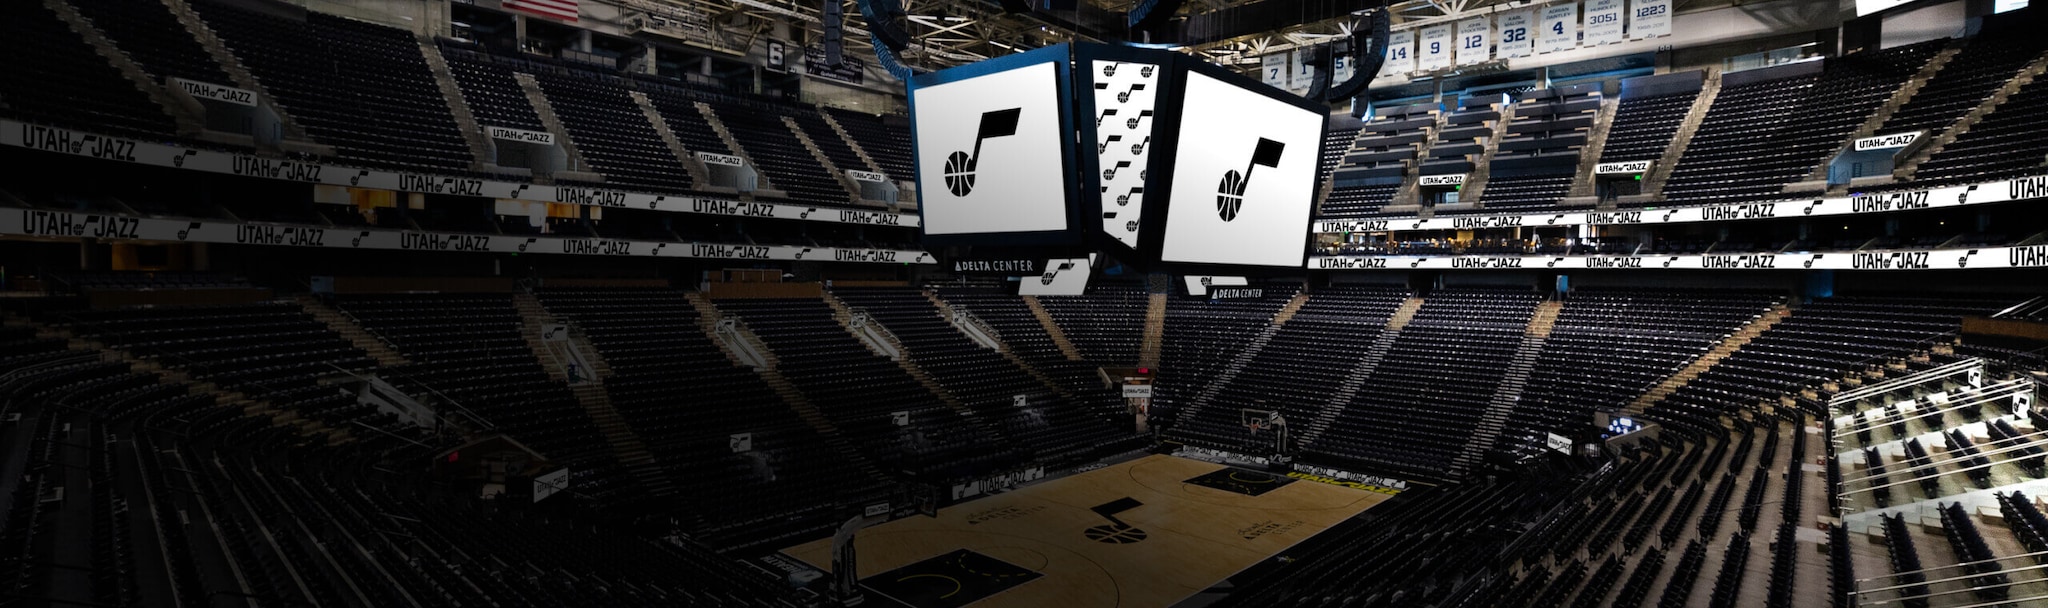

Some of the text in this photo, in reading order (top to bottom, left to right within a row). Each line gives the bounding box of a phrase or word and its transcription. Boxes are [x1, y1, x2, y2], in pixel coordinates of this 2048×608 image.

[1636, 4, 1666, 17] 1223
[1590, 13, 1617, 25] 3051
[1504, 27, 1526, 43] 32
[1553, 22, 1563, 35] 4
[1431, 42, 1440, 54] 9
[1465, 35, 1482, 49] 12
[769, 42, 783, 66] 6
[1392, 47, 1406, 60] 14
[1336, 58, 1343, 69] 5
[1270, 68, 1278, 79] 7
[223, 89, 251, 103] JAZZ
[493, 128, 550, 143] UTAH JAZZ
[23, 124, 135, 162] UTAH JAZZ
[1859, 138, 1880, 148] UTAH
[233, 156, 321, 182] UTAH JAZZ
[1627, 162, 1646, 171] JAZZ
[400, 174, 482, 195] UTAH JAZZ
[1447, 175, 1462, 183] JAZZ
[2010, 179, 2045, 199] UTAH
[557, 187, 625, 206] UTAH JAZZ
[1853, 192, 1928, 212] UTAH JAZZ
[694, 198, 773, 217] UTAH JAZZ
[1703, 204, 1774, 220] UTAH JAZZ
[24, 210, 138, 238] UTAH JAZZ
[841, 209, 898, 225] UTAH JAZZ
[1454, 216, 1522, 228] UTAH JAZZ
[1587, 212, 1641, 224] UTAH JAZZ
[1323, 220, 1388, 232] UTAH JAZZ
[237, 225, 323, 246] UTAH JAZZ
[402, 232, 489, 251] UTAH JAZZ
[564, 239, 630, 254] UTAH JAZZ
[692, 243, 769, 258] UTAH JAZZ
[836, 248, 896, 262] UTAH JAZZ
[1587, 257, 1641, 267] UTAH JAZZ
[1703, 255, 1774, 268] UTAH JAZZ
[1853, 252, 1928, 268] UTAH JAZZ
[2010, 248, 2045, 266] UTAH
[962, 259, 1033, 272] DELTA CENTER
[1320, 258, 1386, 268] UTAH JAZZ
[1452, 257, 1521, 268] UTAH JAZZ
[1219, 288, 1262, 299] DELTA CENTER
[979, 470, 1025, 493] UTAH JAZZ
